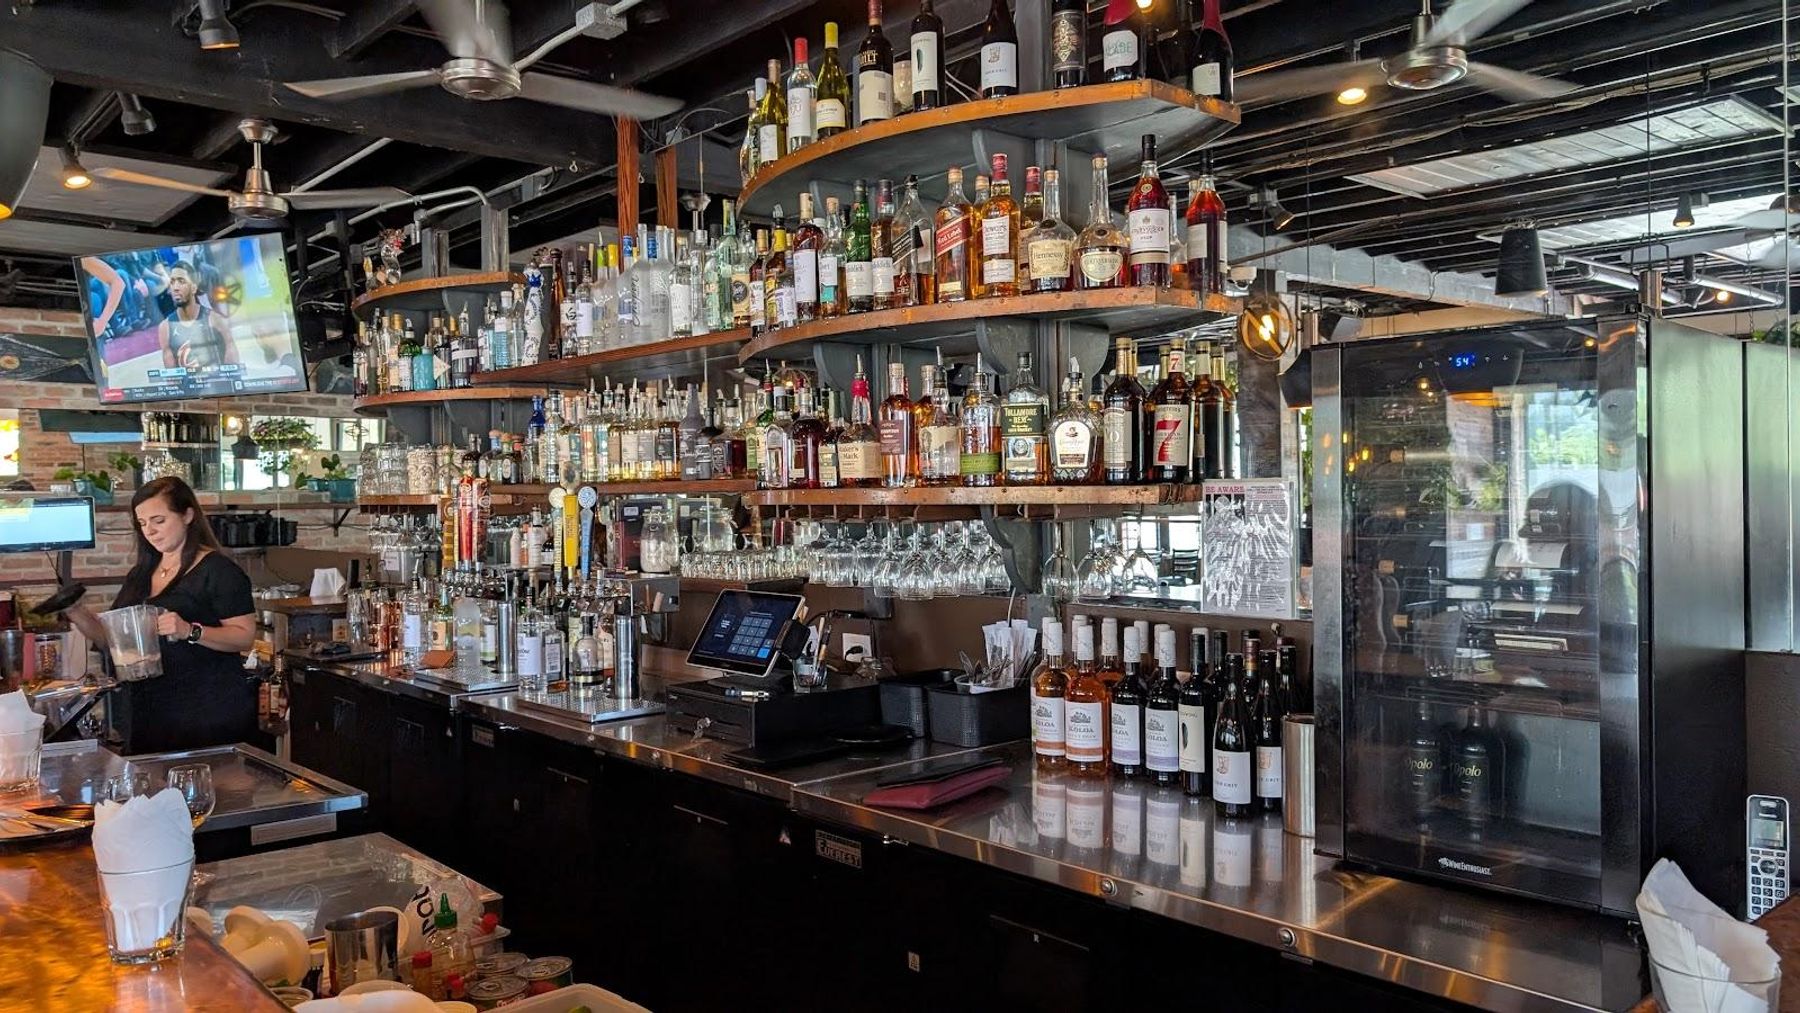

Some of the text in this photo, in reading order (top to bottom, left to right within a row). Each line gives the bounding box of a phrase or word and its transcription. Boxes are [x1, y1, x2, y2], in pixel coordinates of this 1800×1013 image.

[1034, 251, 1064, 260] Hennessy
[1170, 357, 1180, 370] 7
[1456, 357, 1469, 367] 54
[1004, 407, 1037, 417] TULLAMORE
[1155, 419, 1182, 463] 7
